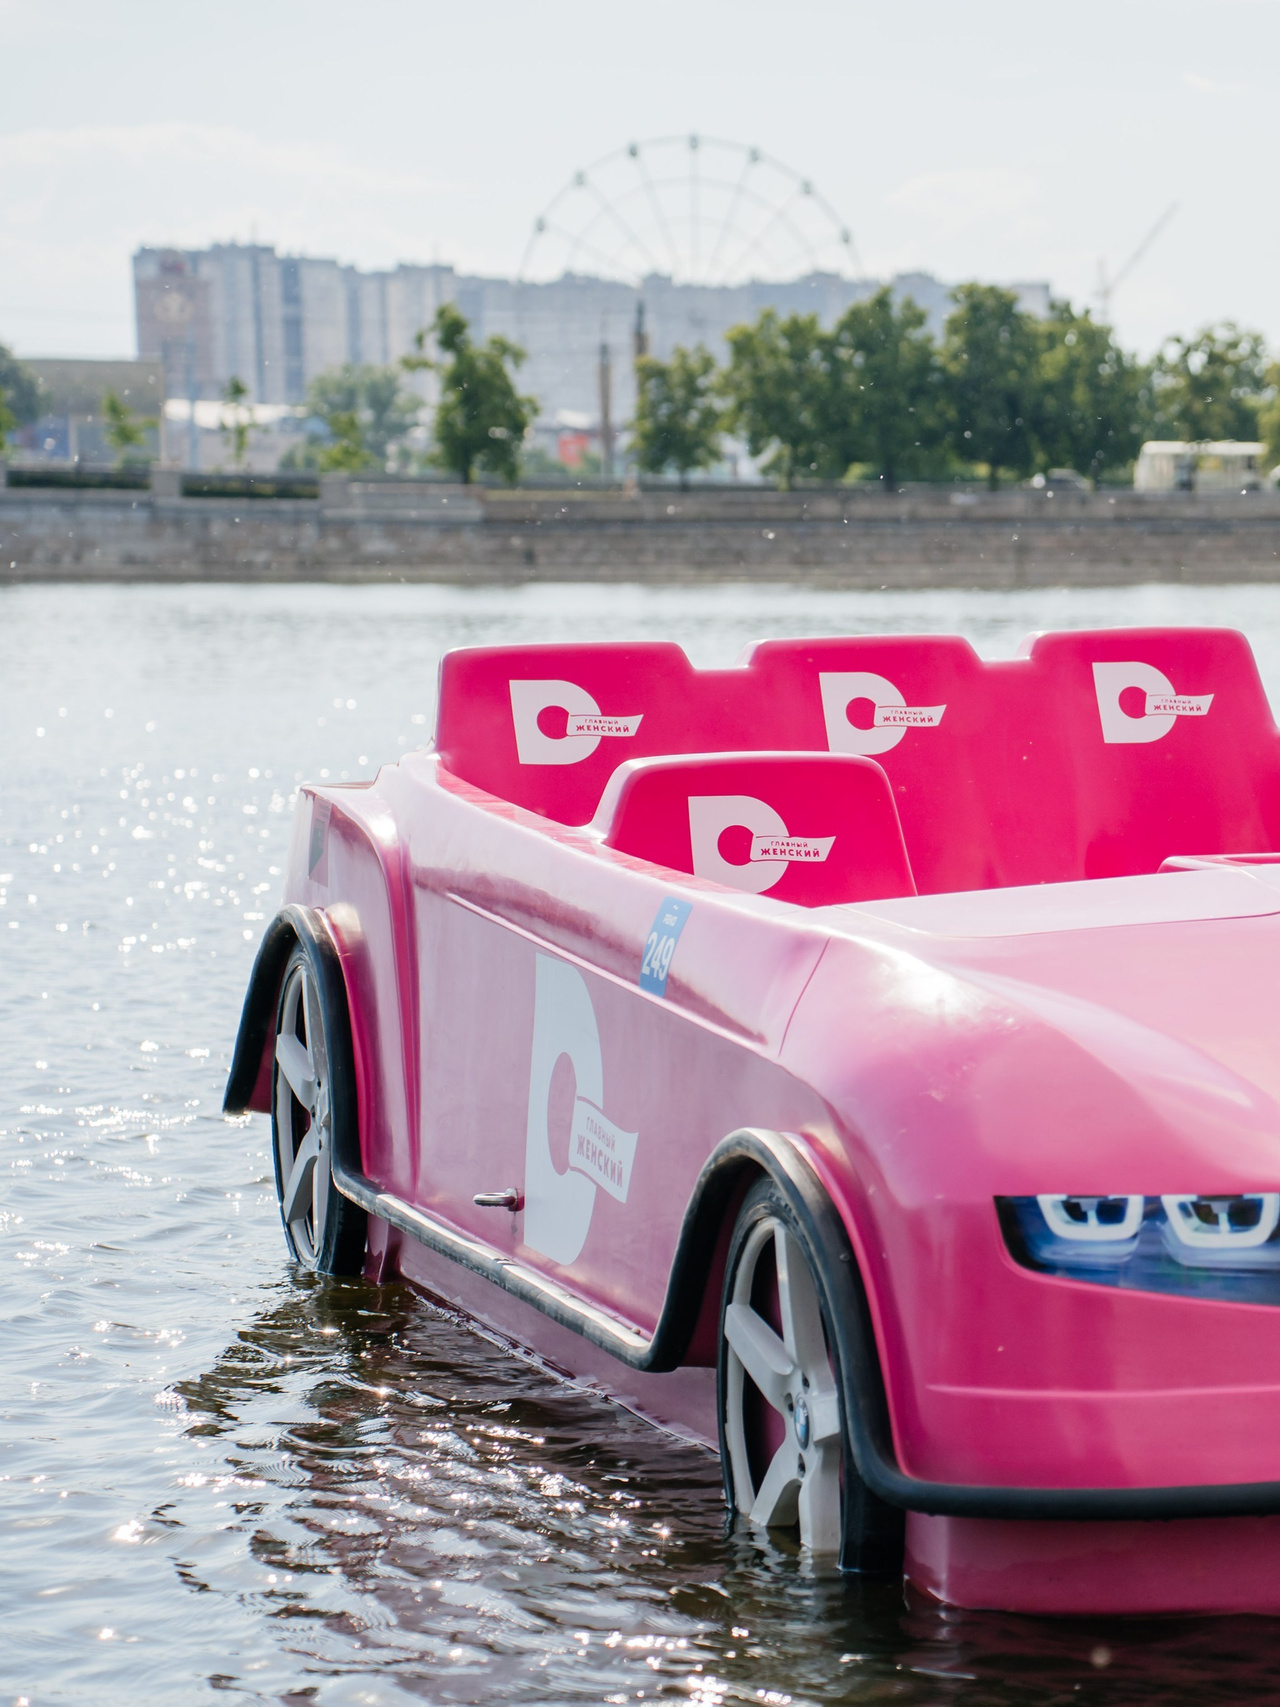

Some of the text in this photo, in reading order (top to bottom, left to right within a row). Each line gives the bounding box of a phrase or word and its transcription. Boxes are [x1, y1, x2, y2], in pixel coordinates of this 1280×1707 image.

[1153, 704, 1202, 712] ЖЕНСКИЙ
[883, 715, 934, 723] ЖЕНСКИЙ
[576, 724, 630, 733] ЖЕНСКИЙ
[761, 848, 820, 858] ЖЕНСКИЙ
[641, 931, 675, 981] 249
[586, 1116, 616, 1153] ГЛАВНЫЙ
[576, 1133, 623, 1188] ЖЕНСКИЙ
